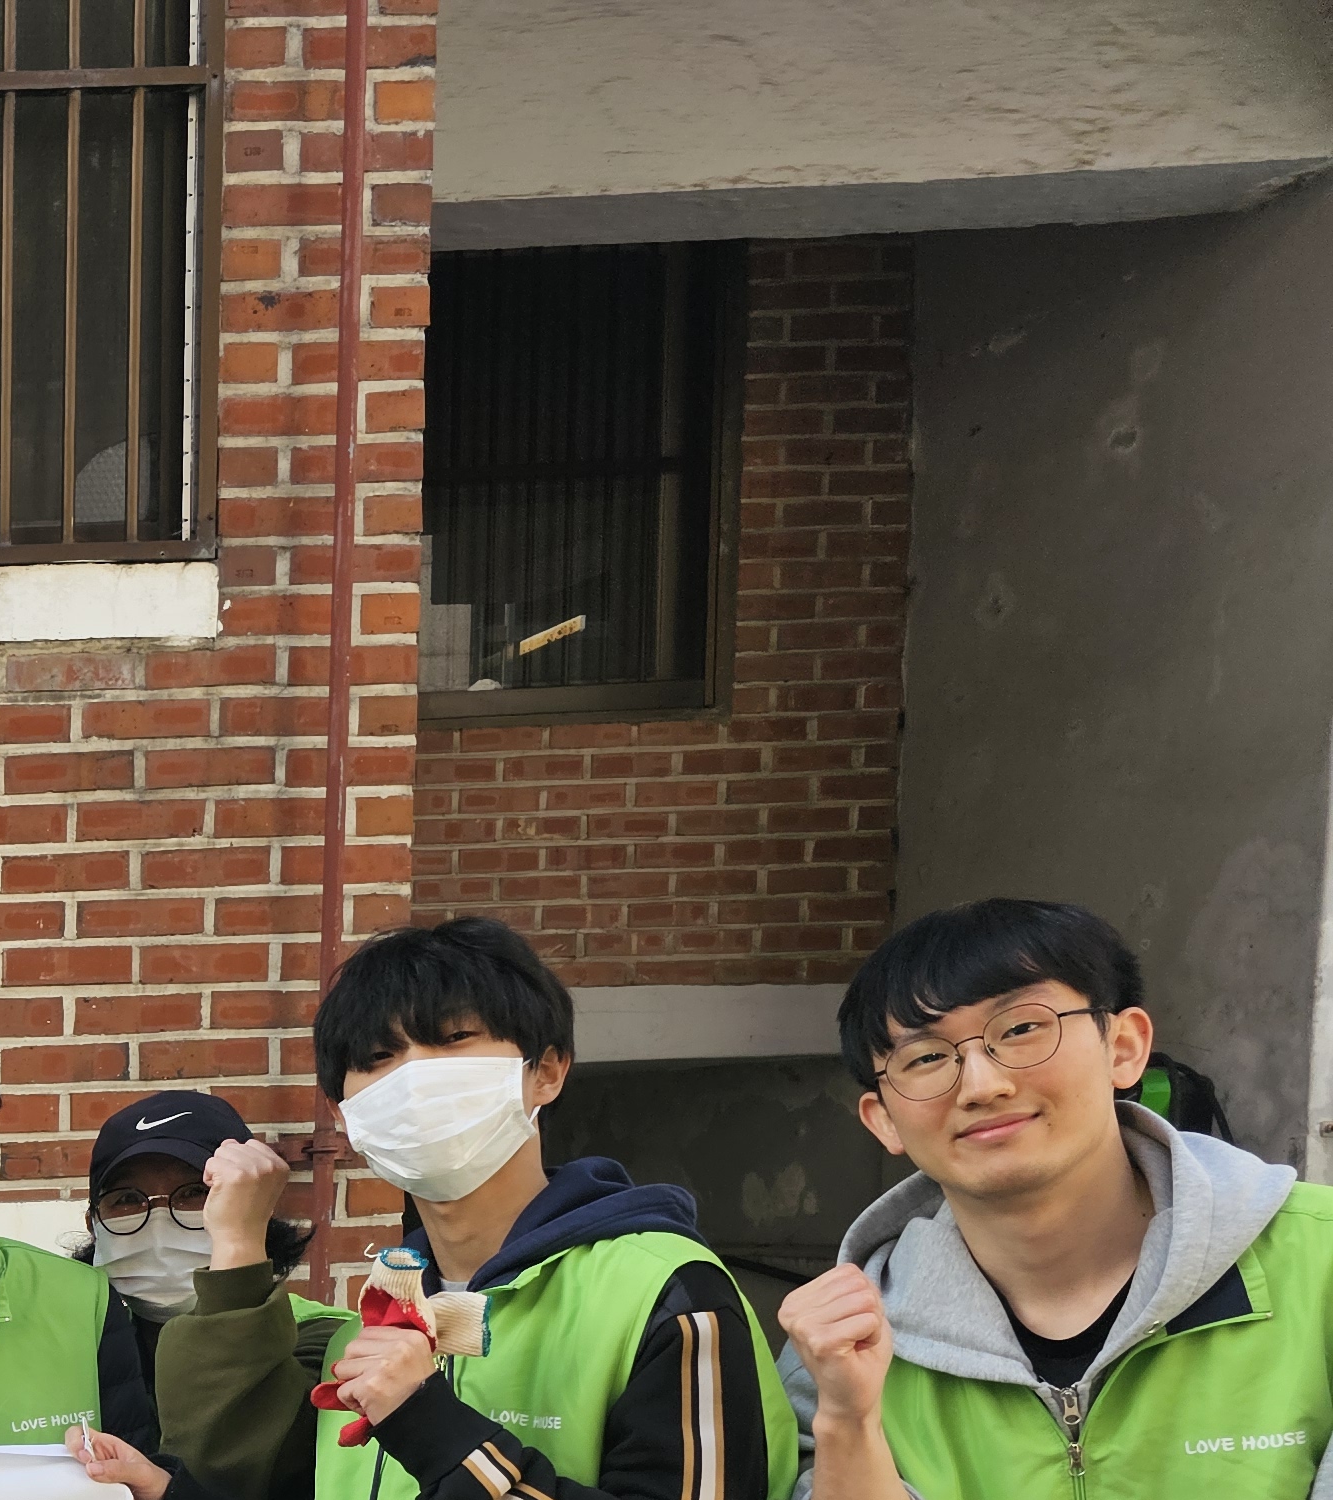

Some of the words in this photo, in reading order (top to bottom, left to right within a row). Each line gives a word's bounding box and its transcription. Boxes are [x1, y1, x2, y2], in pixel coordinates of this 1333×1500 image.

[11, 1417, 48, 1433] LOVE
[50, 1409, 96, 1427] HOUSE
[489, 1408, 530, 1427] LOVE
[1184, 1437, 1235, 1455] LOVE
[1241, 1430, 1307, 1451] HOUSE
